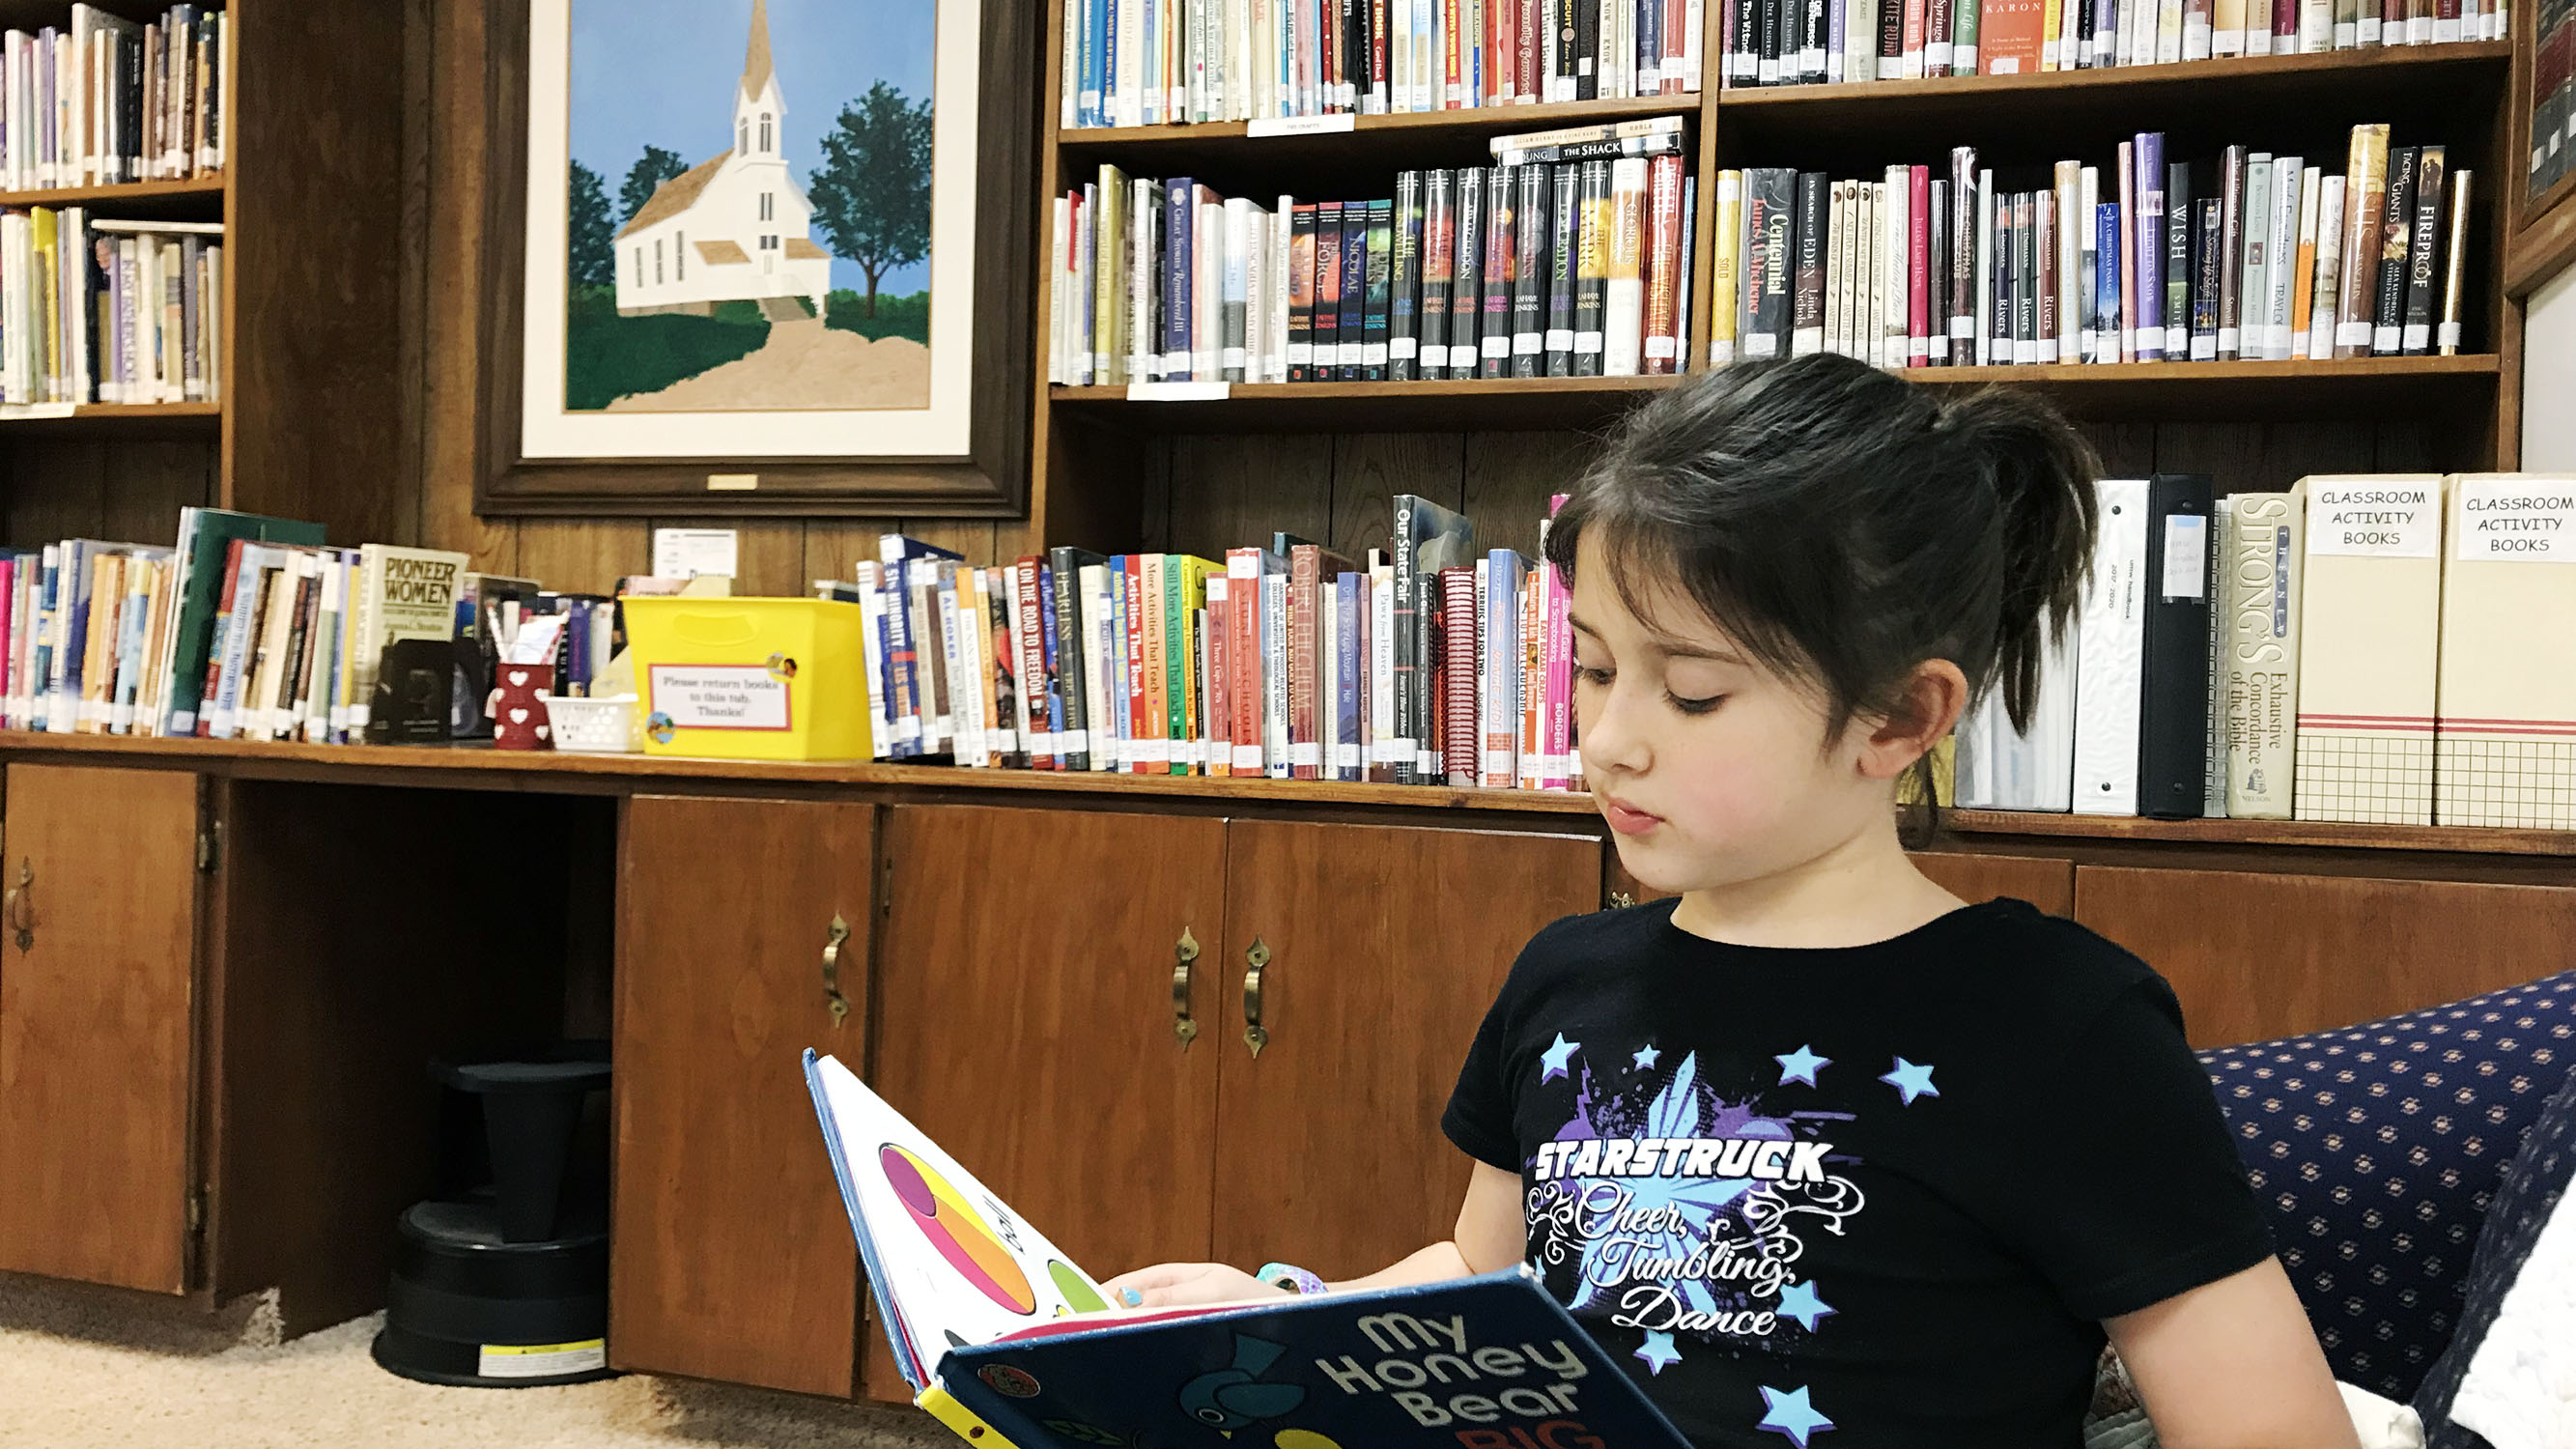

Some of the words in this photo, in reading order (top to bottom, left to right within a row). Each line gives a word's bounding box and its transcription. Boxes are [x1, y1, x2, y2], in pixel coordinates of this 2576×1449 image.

[1742, 1, 1752, 19] The
[1986, 2, 2041, 14] KARON
[1564, 148, 1579, 156] THE
[1582, 143, 1621, 156] SHACK
[2401, 153, 2412, 185] FACING
[2389, 183, 2403, 223] GIANTS
[1174, 208, 1182, 235] GREAT
[1751, 198, 1767, 239] James
[2170, 204, 2187, 260] WISH
[1625, 203, 1637, 265] GLORIOUS
[2414, 206, 2435, 288] FIREPROOF
[1347, 237, 1360, 294] NICOLAE
[1718, 258, 1729, 278] SOLD
[1768, 213, 1789, 295] Centennial
[1802, 238, 1816, 278] EDEN
[1914, 244, 1923, 266] LAST
[1173, 270, 1186, 322] Remembered
[1797, 288, 1807, 326] Nichols
[1807, 289, 1819, 319] Linda
[2225, 297, 2235, 325] Stovall
[1997, 298, 2008, 333] Rivers
[2021, 298, 2032, 332] Rivers
[2044, 296, 2053, 330] Rivers
[2321, 491, 2426, 504] CLASSROOM
[2466, 497, 2575, 511] CLASSROOM
[1397, 509, 1410, 537] Our
[2332, 512, 2415, 525] ACTIVITY
[2477, 518, 2563, 531] ACTIVITY
[2278, 528, 2288, 572] THE
[2343, 532, 2401, 545] BOOKS
[2490, 539, 2550, 553] BOOKS
[385, 557, 457, 581] PIONEER
[1397, 539, 1410, 576] State
[1019, 568, 1034, 583] ON
[1146, 563, 1158, 588] More
[1166, 563, 1178, 583] Still
[1294, 550, 1313, 615] ROBERT
[2236, 497, 2289, 664] STRONG'S
[385, 579, 451, 603] WOMEN
[1020, 585, 1036, 603] THE
[1127, 573, 1140, 629] Activities
[1167, 585, 1178, 613] More
[1397, 576, 1410, 603] Fair
[1419, 582, 1429, 599] Just
[1551, 597, 1559, 607] to
[2124, 581, 2134, 620] handbook
[887, 591, 905, 647] MINORITY
[1022, 606, 1039, 632] ROAD
[1147, 591, 1159, 638] Activities
[1379, 593, 1391, 619] Paws
[1561, 599, 1571, 636] Essential
[2276, 589, 2287, 636] NEW
[1024, 634, 1040, 646] TO
[1168, 615, 1180, 660] Activities
[1379, 620, 1389, 638] from
[1549, 609, 1559, 663] Scrapbooking
[1129, 631, 1141, 660] That
[1149, 639, 1159, 664] That
[1213, 640, 1223, 663] Three
[1380, 639, 1391, 676] Heaven
[1560, 638, 1570, 661] Guide
[1026, 649, 1044, 696] FREEDOM
[1130, 663, 1143, 697] Teach
[1150, 666, 1159, 694] Teach
[1170, 662, 1181, 685] That
[1213, 666, 1224, 683] Cups
[1344, 653, 1352, 681] Mountain
[2230, 671, 2244, 687] of
[663, 676, 697, 688] Please
[702, 679, 740, 689] return
[744, 679, 778, 690] books
[1538, 674, 1546, 704] CRAFTS
[690, 693, 701, 702] to
[704, 693, 725, 702] this
[729, 695, 751, 704] tub.
[696, 706, 745, 718] Thanks!
[1171, 687, 1182, 715] Teach
[1241, 669, 1252, 746] SCHOOLS
[2229, 690, 2245, 711] the
[2268, 672, 2288, 749] Exhaustive
[1553, 703, 1564, 750] BORDERS
[2248, 672, 2267, 764] Concordance
[2228, 716, 2245, 752] Bible
[1535, 1138, 1835, 1182] STARSTRUCK
[1575, 1180, 1688, 1239] Cheer,
[1586, 1236, 1797, 1297] Tumbling,
[1611, 1285, 1777, 1336] Dance
[1357, 1312, 1466, 1352] My
[1315, 1339, 1589, 1395] Honey
[1391, 1381, 1580, 1428] Bear
